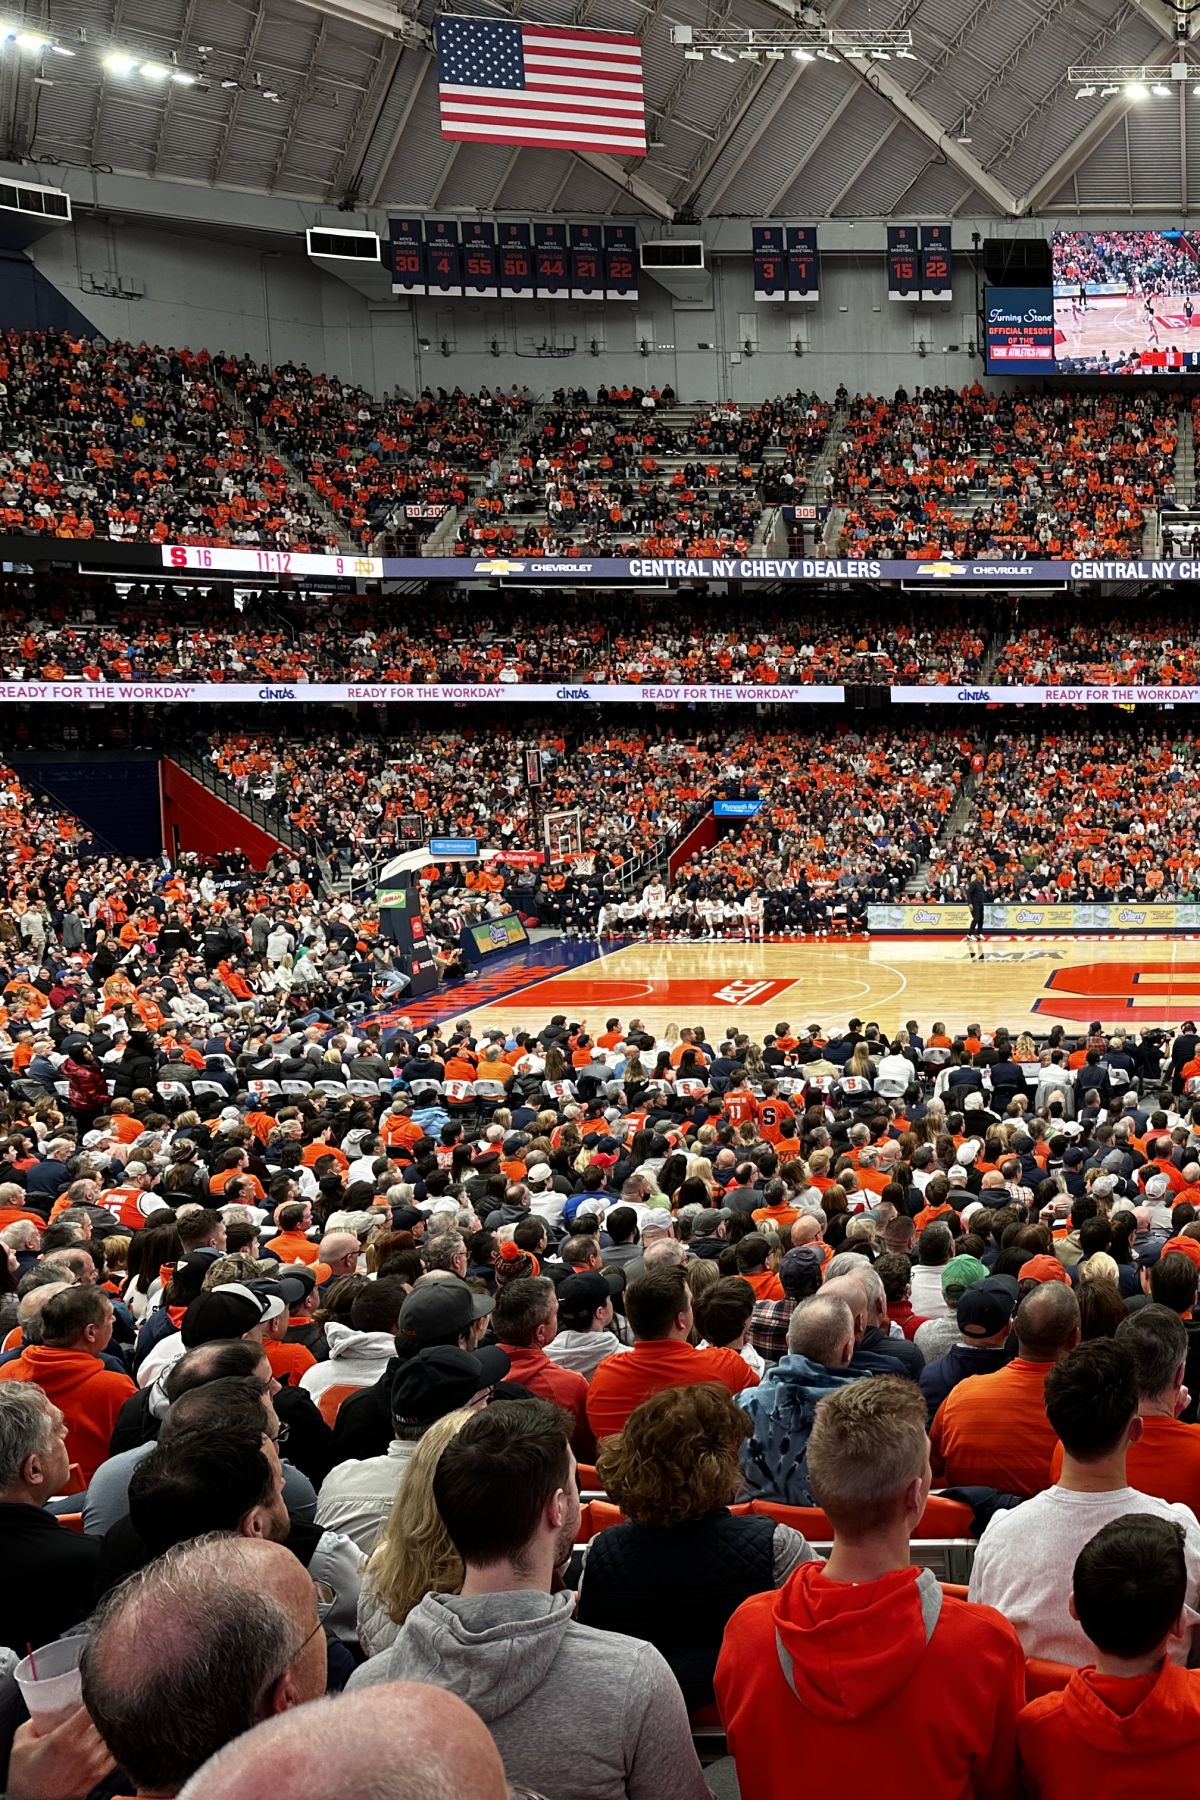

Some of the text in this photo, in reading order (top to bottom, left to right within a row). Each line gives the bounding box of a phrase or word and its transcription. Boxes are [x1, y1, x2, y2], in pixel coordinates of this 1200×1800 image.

[396, 257, 420, 272] 30
[437, 258, 450, 273] 4
[468, 259, 492, 274] 55
[504, 260, 527, 275] 50
[539, 261, 564, 276] 44
[577, 262, 597, 277] 21
[610, 262, 633, 278] 22
[763, 263, 774, 279] 3
[799, 264, 806, 278] 1
[894, 263, 913, 279] 15
[926, 262, 947, 278] 22
[988, 308, 1051, 324] Turning Stone
[989, 327, 1053, 335] OFFICIAL RESORT
[1008, 337, 1034, 345] OF THE
[1166, 352, 1175, 365] 16
[1192, 352, 1198, 365] 9
[796, 508, 815, 517] 309
[170, 547, 187, 567] S
[196, 550, 211, 567] 16
[257, 552, 292, 573] 11:12
[336, 558, 344, 574] 9
[531, 563, 593, 572] CHEVROLET
[629, 559, 881, 578] CENTRAL NY CHEVY DEALERS
[972, 566, 1034, 575] CHEVROLET
[1070, 562, 1149, 579] CENTRAL
[1151, 562, 1176, 579] NY
[0, 687, 48, 698] READY
[53, 687, 83, 697] FOR
[86, 687, 115, 698] THE
[347, 687, 388, 698] READY
[390, 687, 412, 698] FOR
[416, 687, 440, 698] THE
[641, 688, 681, 699] READY
[683, 688, 708, 699] FOR
[709, 688, 733, 700] THE
[1045, 689, 1084, 700] READY
[1086, 689, 1110, 701] FOR
[1111, 689, 1134, 700] THE
[912, 909, 942, 925] Starry
[1015, 909, 1045, 925] Starry
[1118, 908, 1148, 924] Starry
[728, 1105, 741, 1120] 11
[762, 1106, 777, 1127] S
